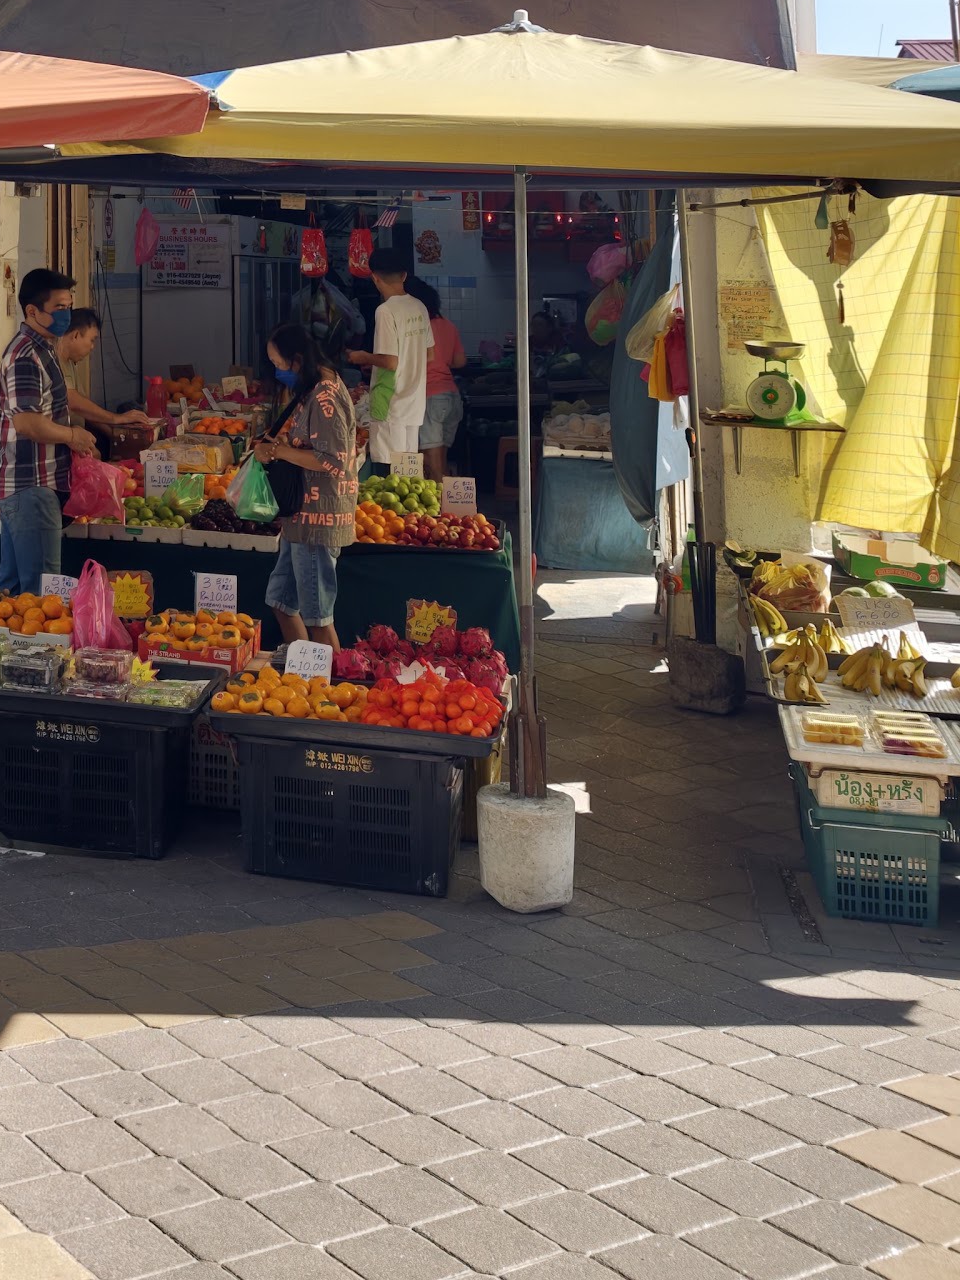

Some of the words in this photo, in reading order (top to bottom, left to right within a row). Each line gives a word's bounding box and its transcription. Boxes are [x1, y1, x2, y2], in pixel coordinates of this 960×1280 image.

[156, 465, 162, 474] 8
[203, 577, 211, 589] 3
[159, 651, 181, 659] STRAND
[299, 647, 307, 657] 4
[60, 723, 73, 734] WEI
[74, 724, 86, 736] XIN
[331, 753, 345, 764] WEI
[347, 754, 360, 766] XIN
